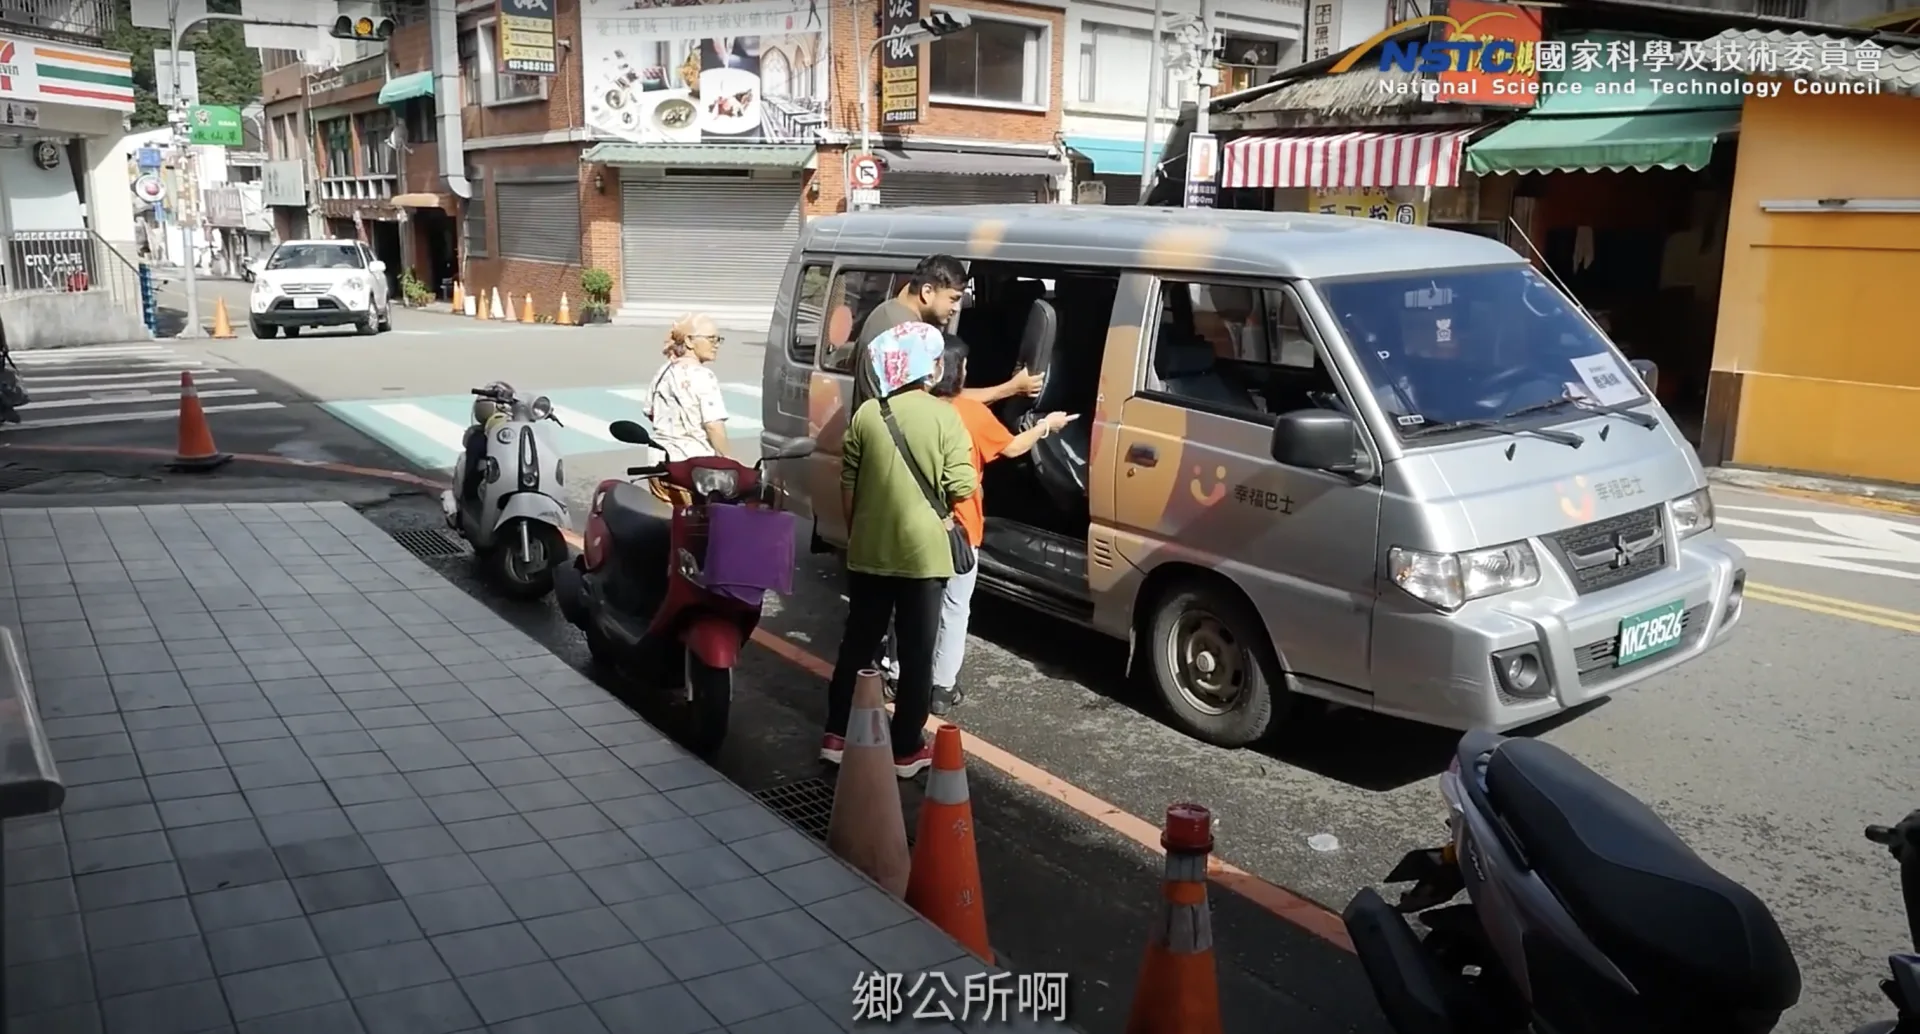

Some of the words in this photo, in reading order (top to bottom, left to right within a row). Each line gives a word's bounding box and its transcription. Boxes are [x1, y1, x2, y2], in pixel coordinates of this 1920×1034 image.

[25, 253, 52, 266] CITY
[54, 252, 82, 265] CAFE
[1234, 484, 1295, 515] 幸福巴士
[1594, 476, 1646, 502] 幸福巴士
[1620, 609, 1684, 658] KKZ-8526
